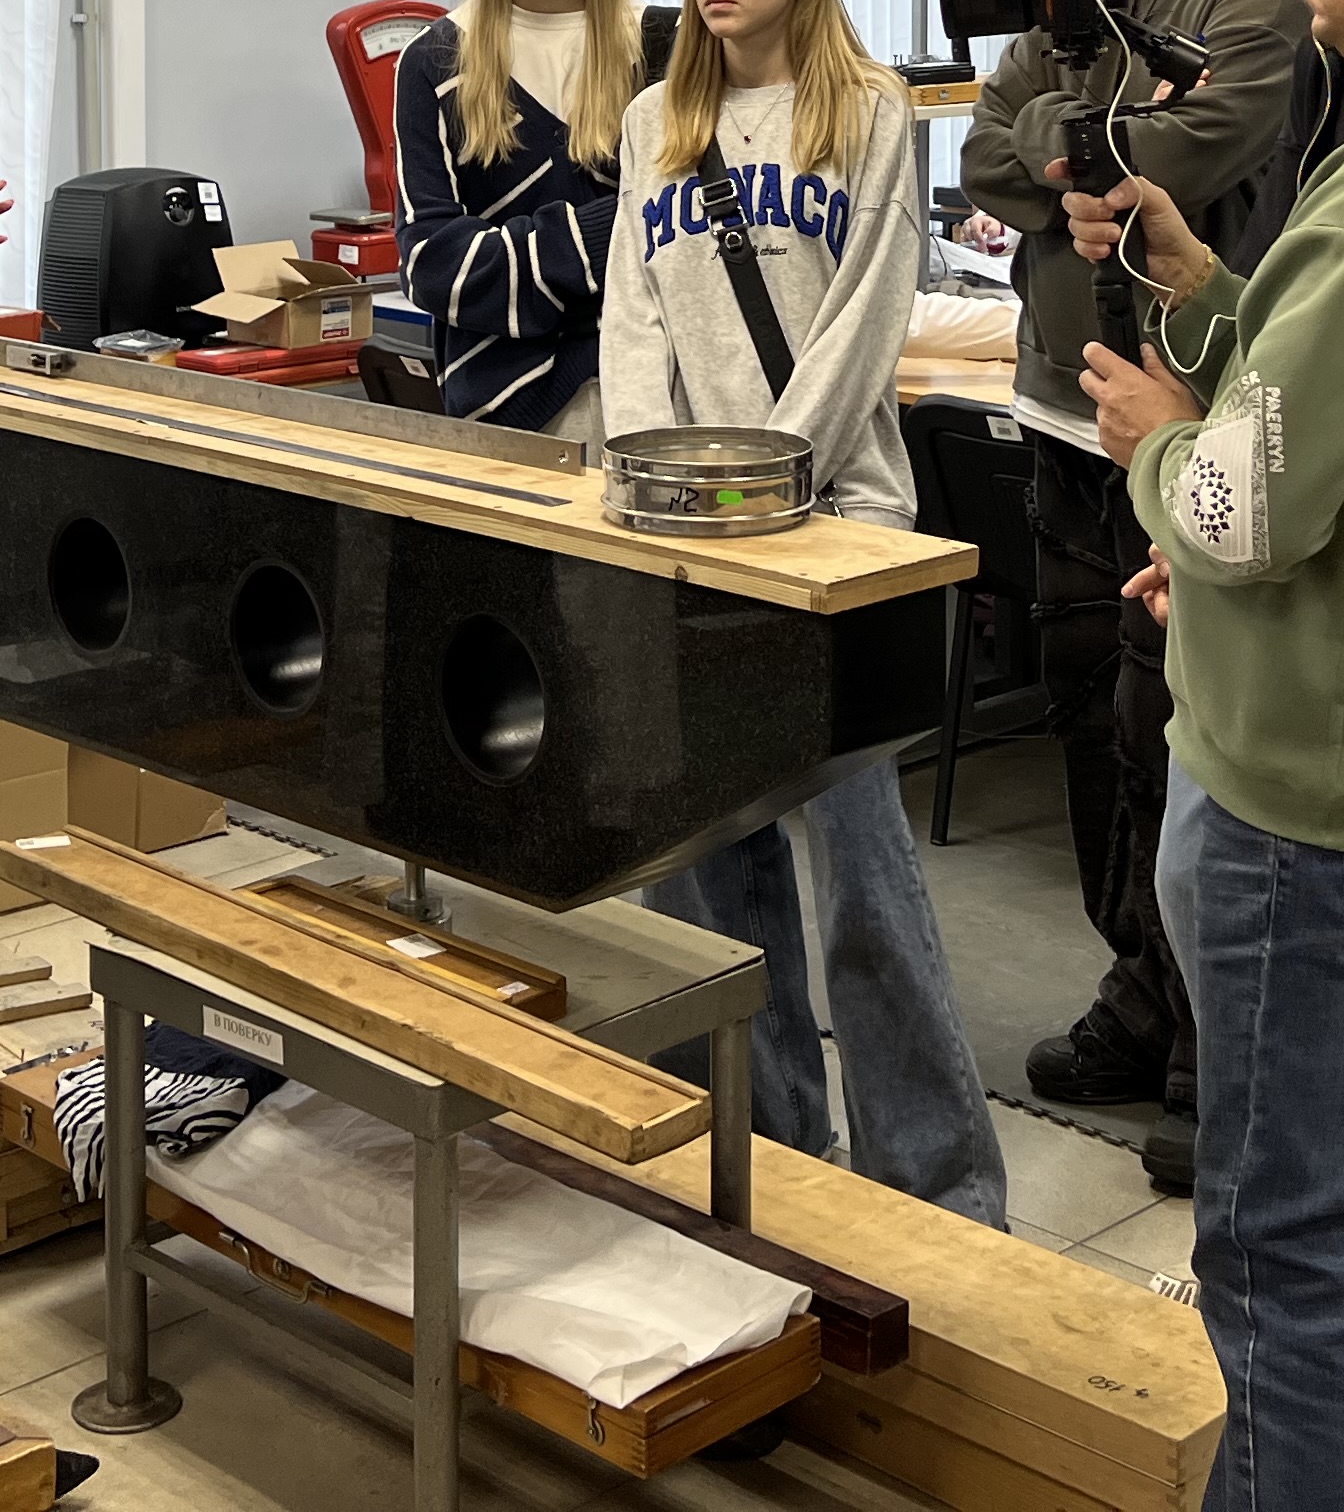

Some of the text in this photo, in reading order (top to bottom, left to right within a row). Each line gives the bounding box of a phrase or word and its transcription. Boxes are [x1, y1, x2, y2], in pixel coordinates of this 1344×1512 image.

[642, 162, 850, 271] MONACO
[213, 1013, 272, 1046] В ПОВЕРКУ
